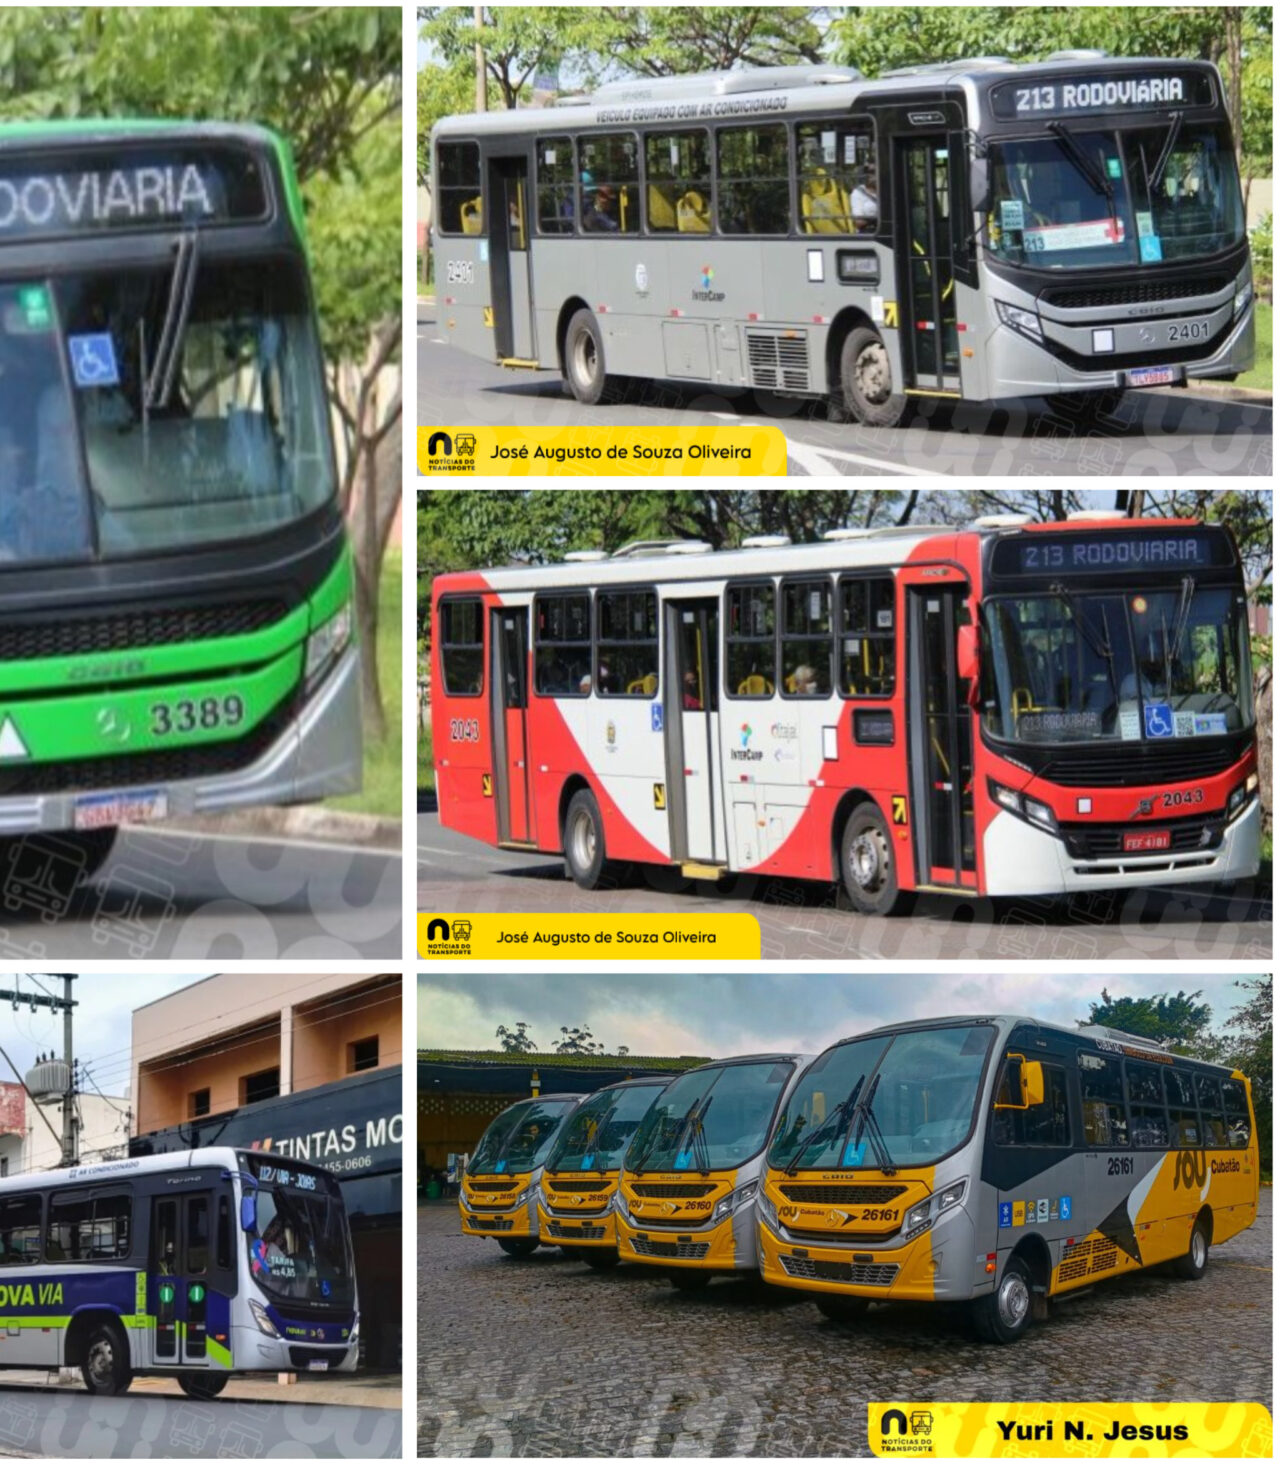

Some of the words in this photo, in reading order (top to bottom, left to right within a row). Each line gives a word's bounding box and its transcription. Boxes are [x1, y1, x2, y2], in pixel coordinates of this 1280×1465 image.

[633, 106, 675, 121] EQUIPADO
[677, 104, 697, 118] COM
[700, 102, 713, 115] AR
[714, 96, 788, 114] CONDICIONADO
[1016, 87, 1055, 111] 213
[1025, 237, 1046, 251] 213
[1169, 322, 1210, 342] 2401
[1025, 547, 1063, 567] 213
[151, 694, 245, 736] 3389
[451, 720, 480, 743] 2043
[1163, 789, 1204, 807] 2043
[276, 1124, 356, 1160] TINTAS
[88, 1161, 140, 1175] CONDICIONADO
[1108, 1157, 1134, 1176] 26161
[1211, 1157, 1241, 1174] Cubatão
[685, 1200, 712, 1211] 26160
[861, 1209, 900, 1221] 26161
[38, 1283, 63, 1305] VIA
